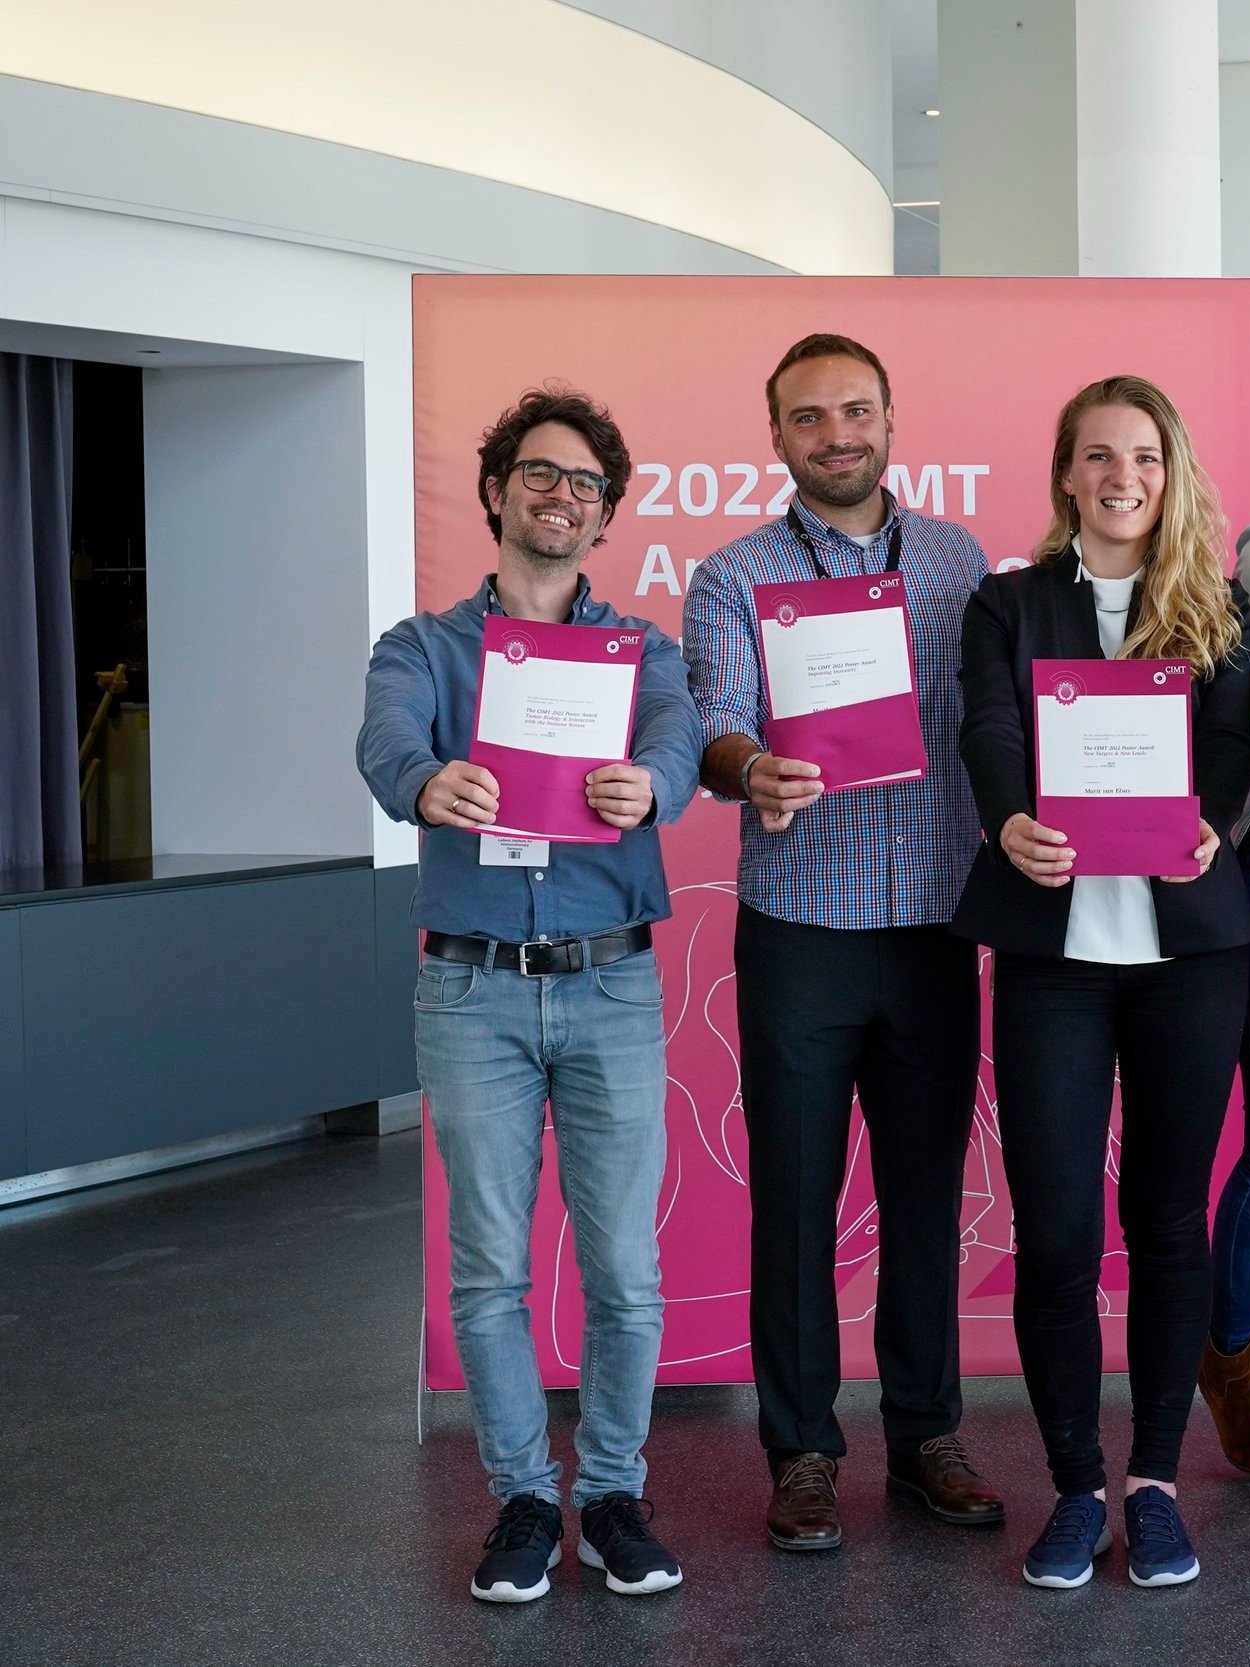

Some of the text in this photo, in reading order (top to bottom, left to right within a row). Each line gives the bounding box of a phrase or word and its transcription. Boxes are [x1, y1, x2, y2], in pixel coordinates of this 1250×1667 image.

[636, 463, 798, 516] 2022
[879, 578, 900, 588] CIMT
[619, 635, 640, 644] CIMT
